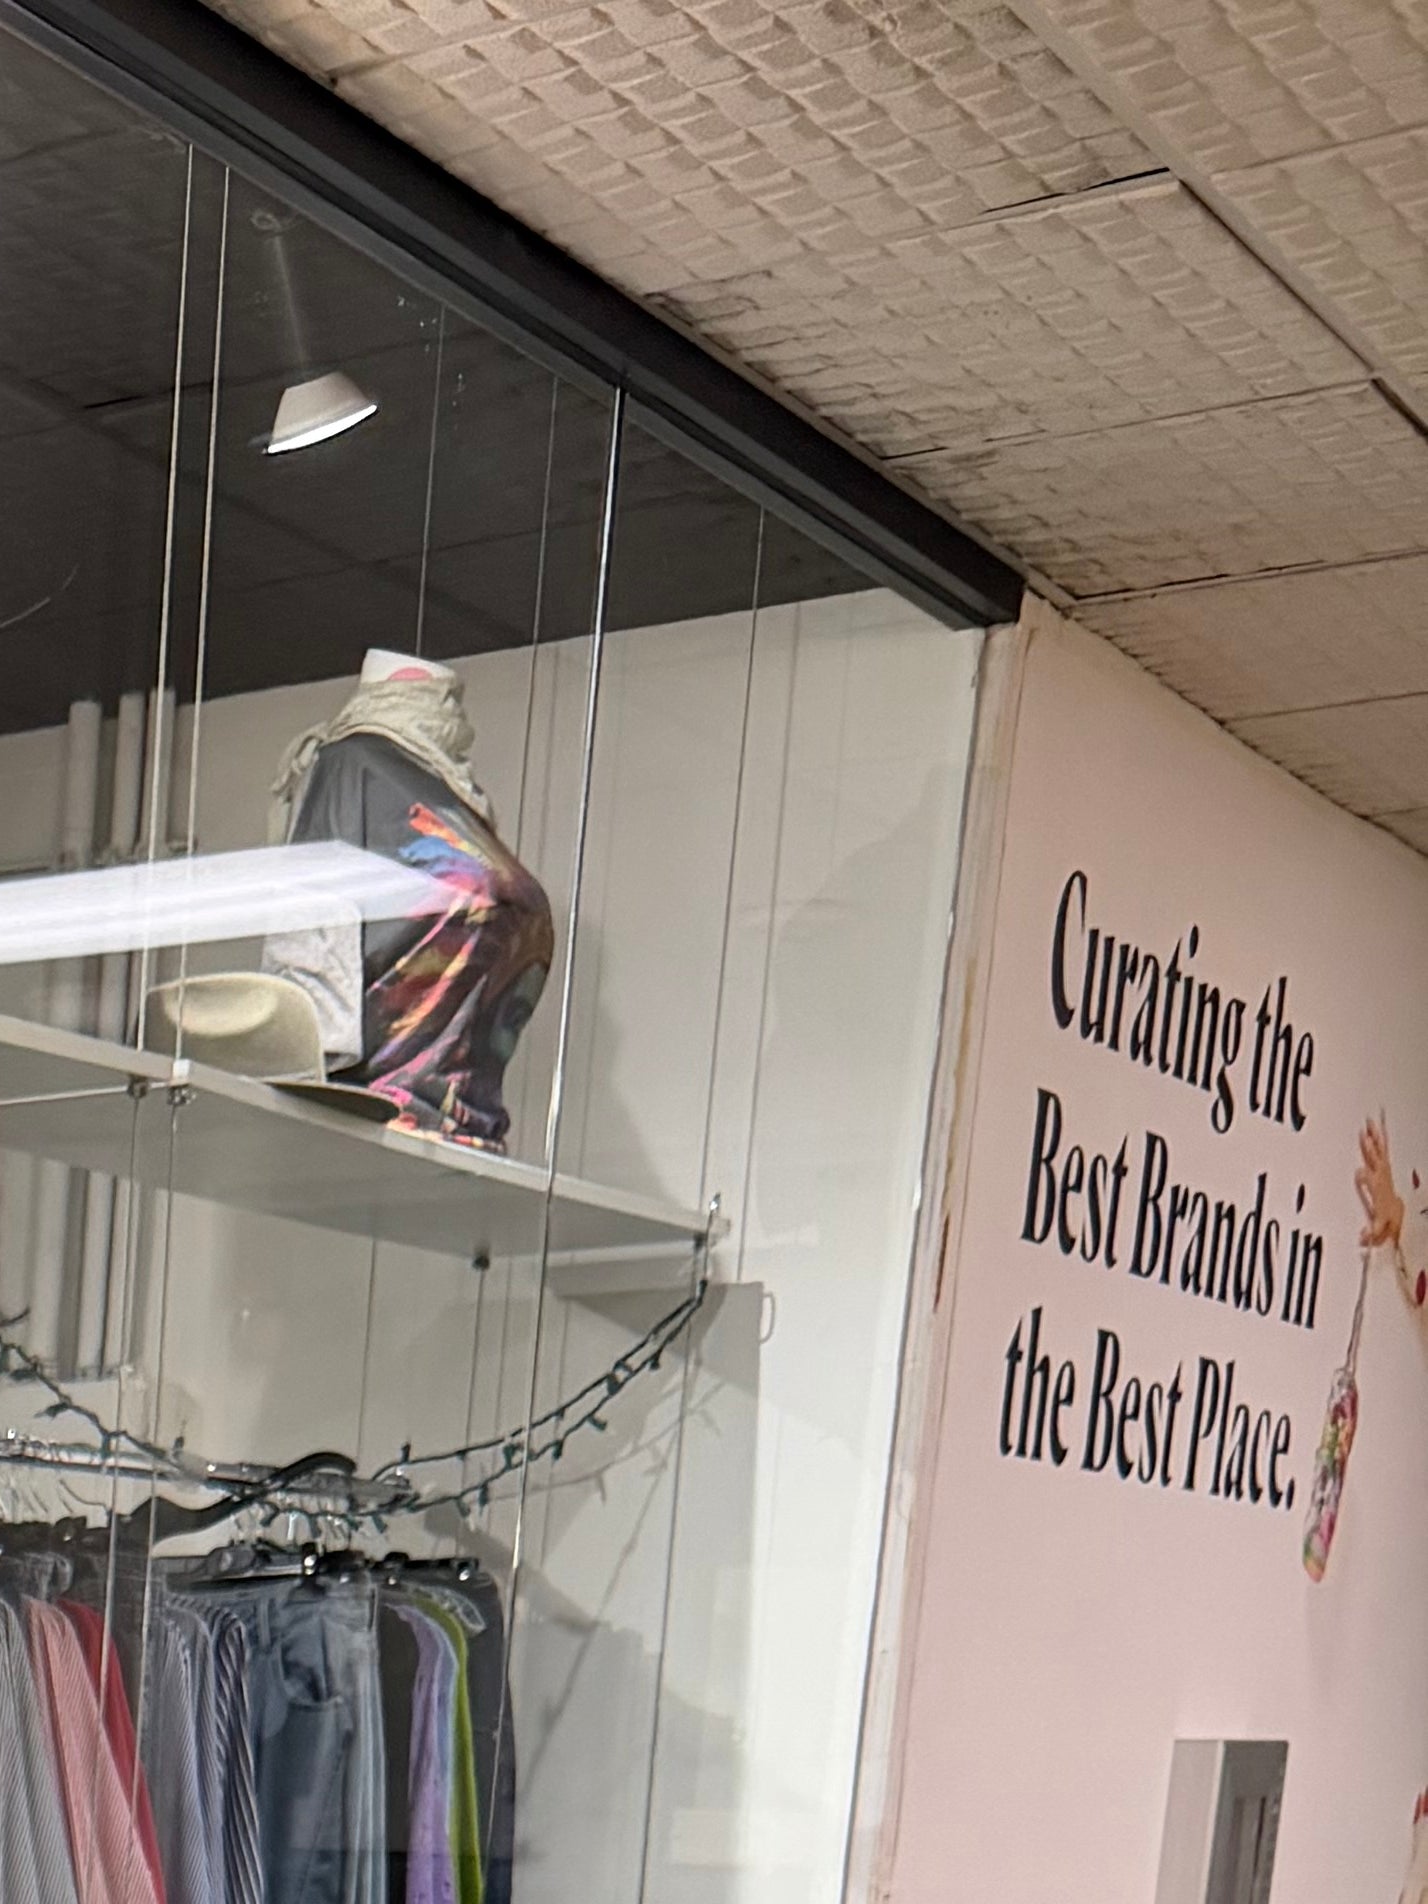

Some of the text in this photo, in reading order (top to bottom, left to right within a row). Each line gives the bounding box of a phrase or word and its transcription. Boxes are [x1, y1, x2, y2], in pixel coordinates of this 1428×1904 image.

[1051, 870, 1313, 1134] Curating the
[1021, 1087, 1323, 1329] Best Brands in
[1000, 1306, 1295, 1511] the Best Place.
